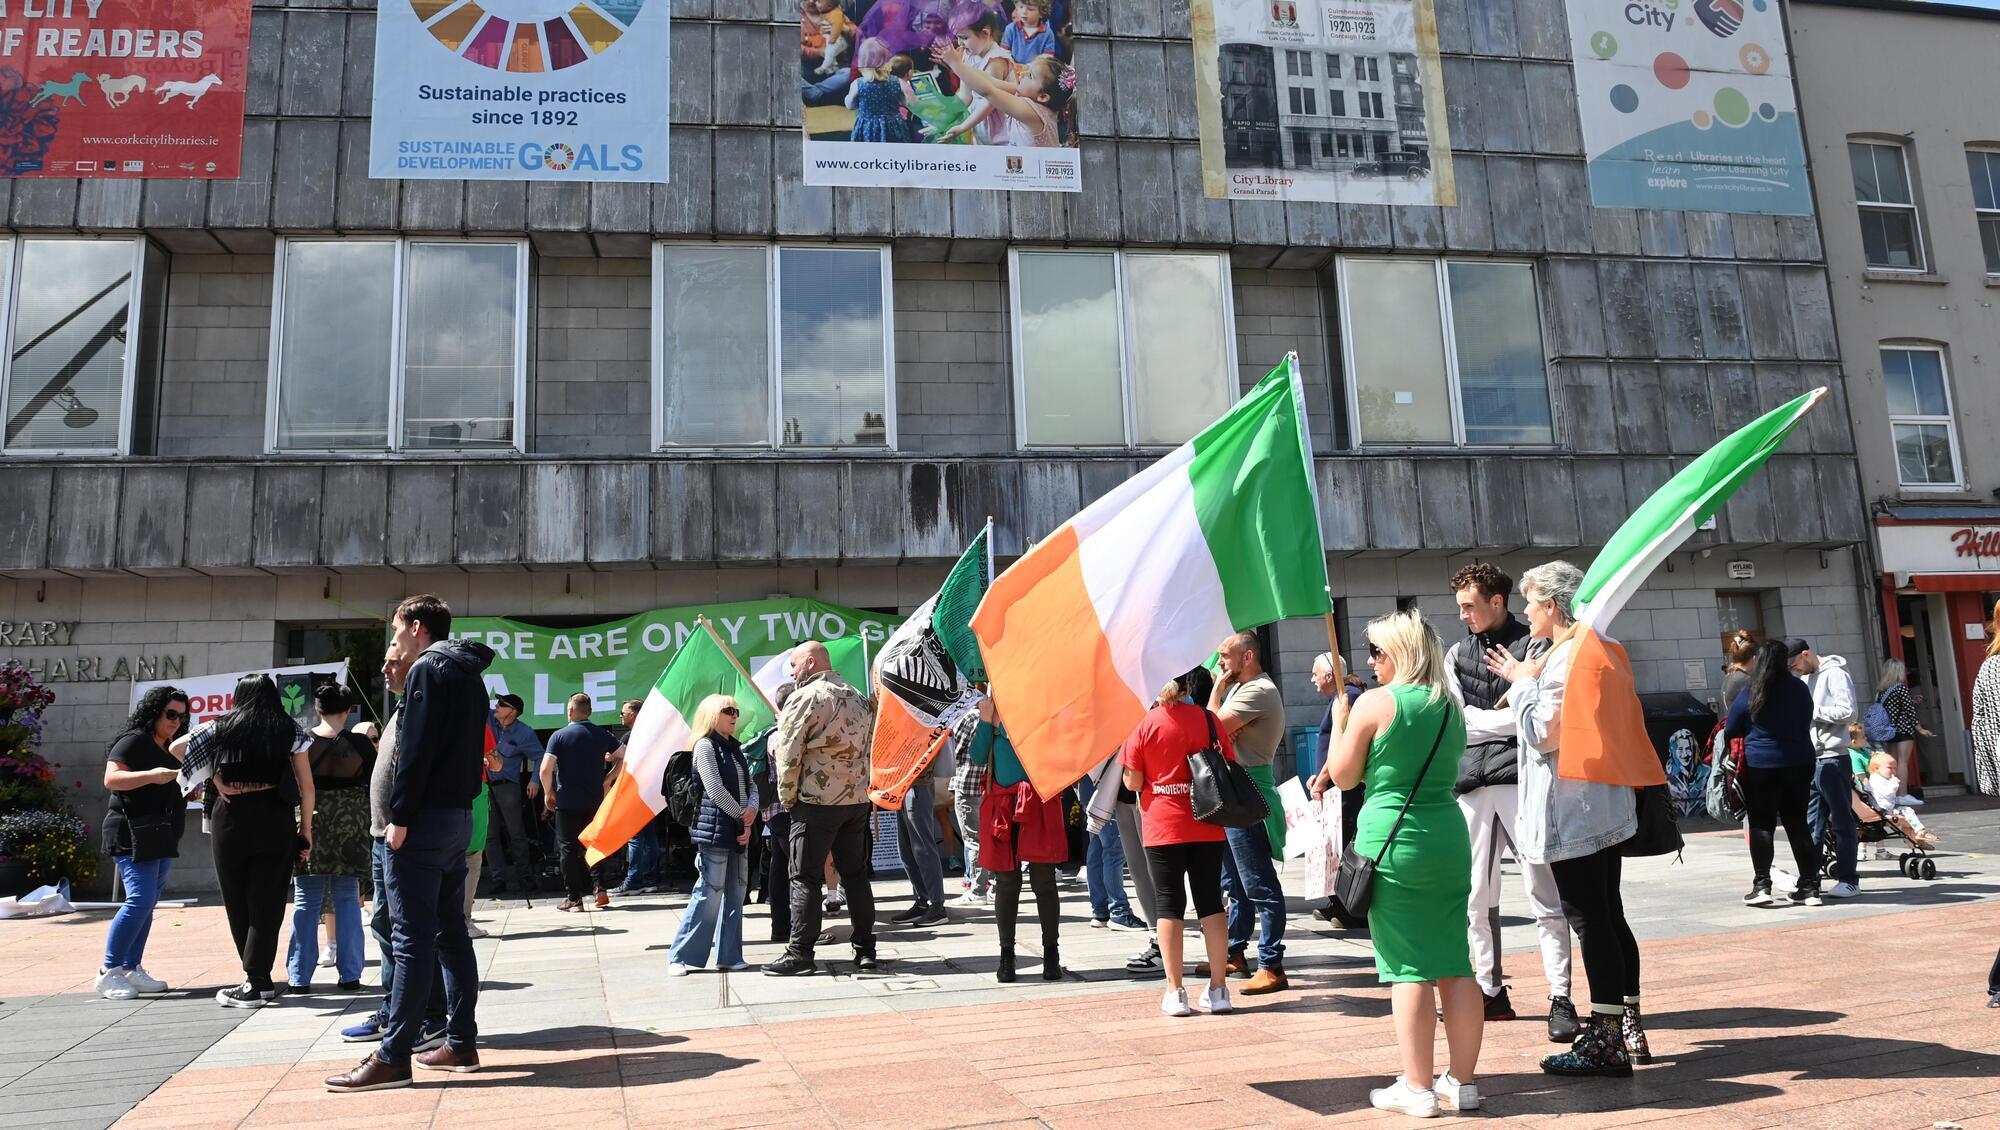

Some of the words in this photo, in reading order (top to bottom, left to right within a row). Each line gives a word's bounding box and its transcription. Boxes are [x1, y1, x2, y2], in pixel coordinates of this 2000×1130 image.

[1624, 3, 1676, 33] City
[1329, 20, 1376, 34] 1920-1923
[0, 28, 25, 57] F
[36, 29, 204, 58] READERS
[418, 84, 533, 103] Sustainable
[538, 87, 627, 106] practices
[471, 109, 524, 125] since
[529, 110, 578, 126] 1892
[82, 133, 220, 149] www.corkcitylibraries.ie
[398, 140, 516, 155] SUSTAINABLE
[397, 156, 515, 170] DEVELOPMENT
[518, 142, 644, 172] GOALS
[1643, 149, 1683, 162] Read
[1690, 151, 1733, 163] Libraries
[1745, 154, 1760, 164] the
[1762, 155, 1787, 166] heart
[815, 158, 978, 174] www.corkcitylibraries.ie
[1651, 162, 1681, 175] learn
[1703, 163, 1728, 173] Cork
[1728, 165, 1768, 177] Learning
[1769, 167, 1789, 177] City
[1232, 173, 1254, 186] City
[1256, 174, 1295, 188] Library
[1647, 175, 1688, 190] explore
[1233, 187, 1255, 195] Grand
[548, 626, 629, 660] ARE
[759, 611, 847, 641] TWO
[28, 654, 186, 683] HARLANN
[482, 669, 617, 716] ALE
[189, 693, 236, 714] ORK
